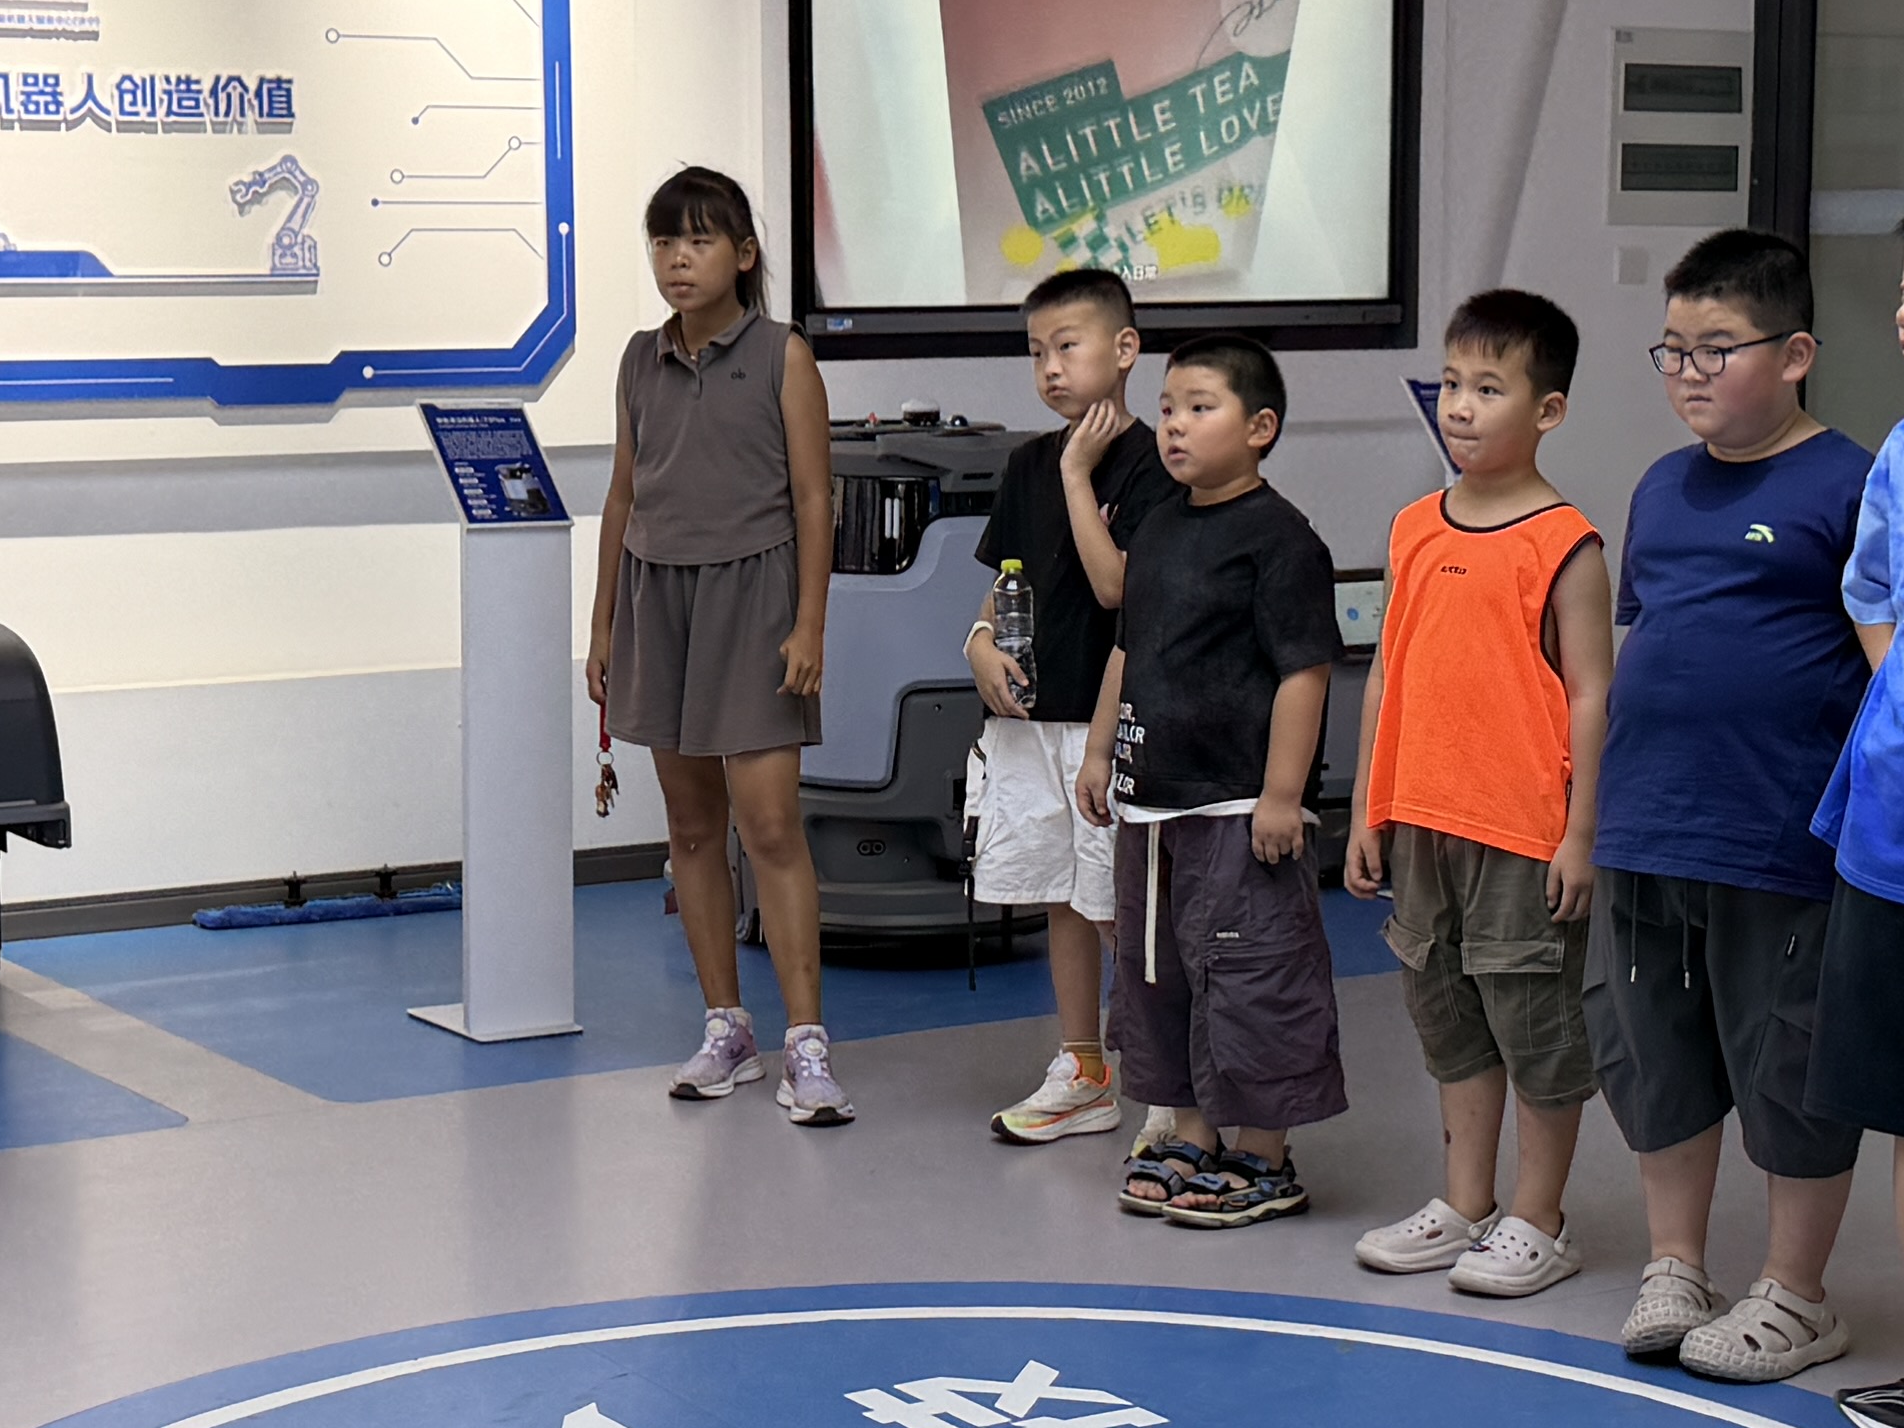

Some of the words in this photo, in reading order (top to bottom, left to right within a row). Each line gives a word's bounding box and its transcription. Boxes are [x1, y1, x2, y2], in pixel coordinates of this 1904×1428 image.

[998, 93, 1059, 128] SINCE
[1063, 76, 1109, 106] 2012
[1188, 61, 1259, 114] TEA
[1200, 92, 1283, 158] LOVE
